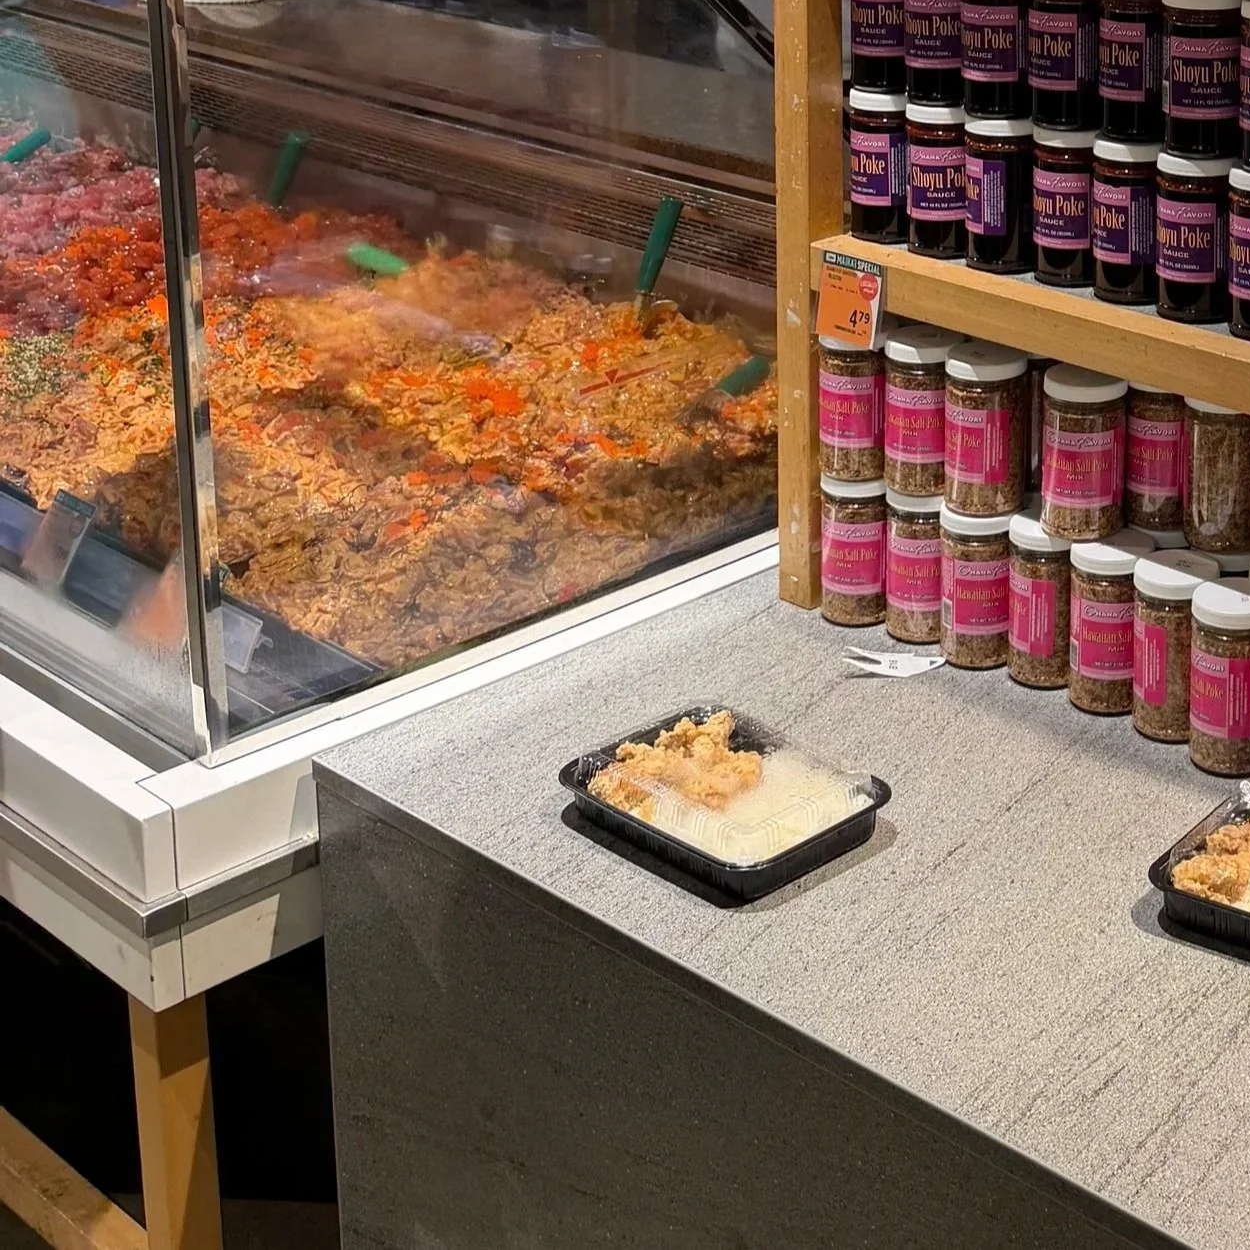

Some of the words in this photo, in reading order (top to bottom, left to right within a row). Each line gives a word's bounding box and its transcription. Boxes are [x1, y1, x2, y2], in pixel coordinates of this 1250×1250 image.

[860, 27, 886, 35] SAUCE
[933, 16, 960, 36] Poke
[984, 28, 1013, 49] Poke
[1044, 34, 1072, 57] Poke
[967, 51, 993, 59] SAUCE
[1112, 43, 1139, 67] Poke
[1173, 58, 1209, 87] Shoyu
[860, 153, 885, 175] Poke
[912, 166, 943, 191] Shoyu
[1056, 194, 1085, 217] Poke
[1039, 216, 1065, 226] SAUCE
[1101, 206, 1125, 230] Poke
[1180, 225, 1211, 249] Poke
[1163, 248, 1190, 259] SAUCE
[857, 260, 880, 275] SPECIAL
[836, 400, 850, 415] Salt
[852, 401, 869, 414] Poke
[911, 416, 925, 429] Salt
[964, 433, 981, 447] Poke
[1141, 447, 1155, 460] Salt
[1157, 447, 1175, 461] Poke
[1077, 458, 1091, 473] Salt
[914, 565, 929, 577] Salt
[957, 585, 990, 600] Hawaiian
[1082, 626, 1116, 644] Hawaiian
[1206, 682, 1223, 699] Poke
